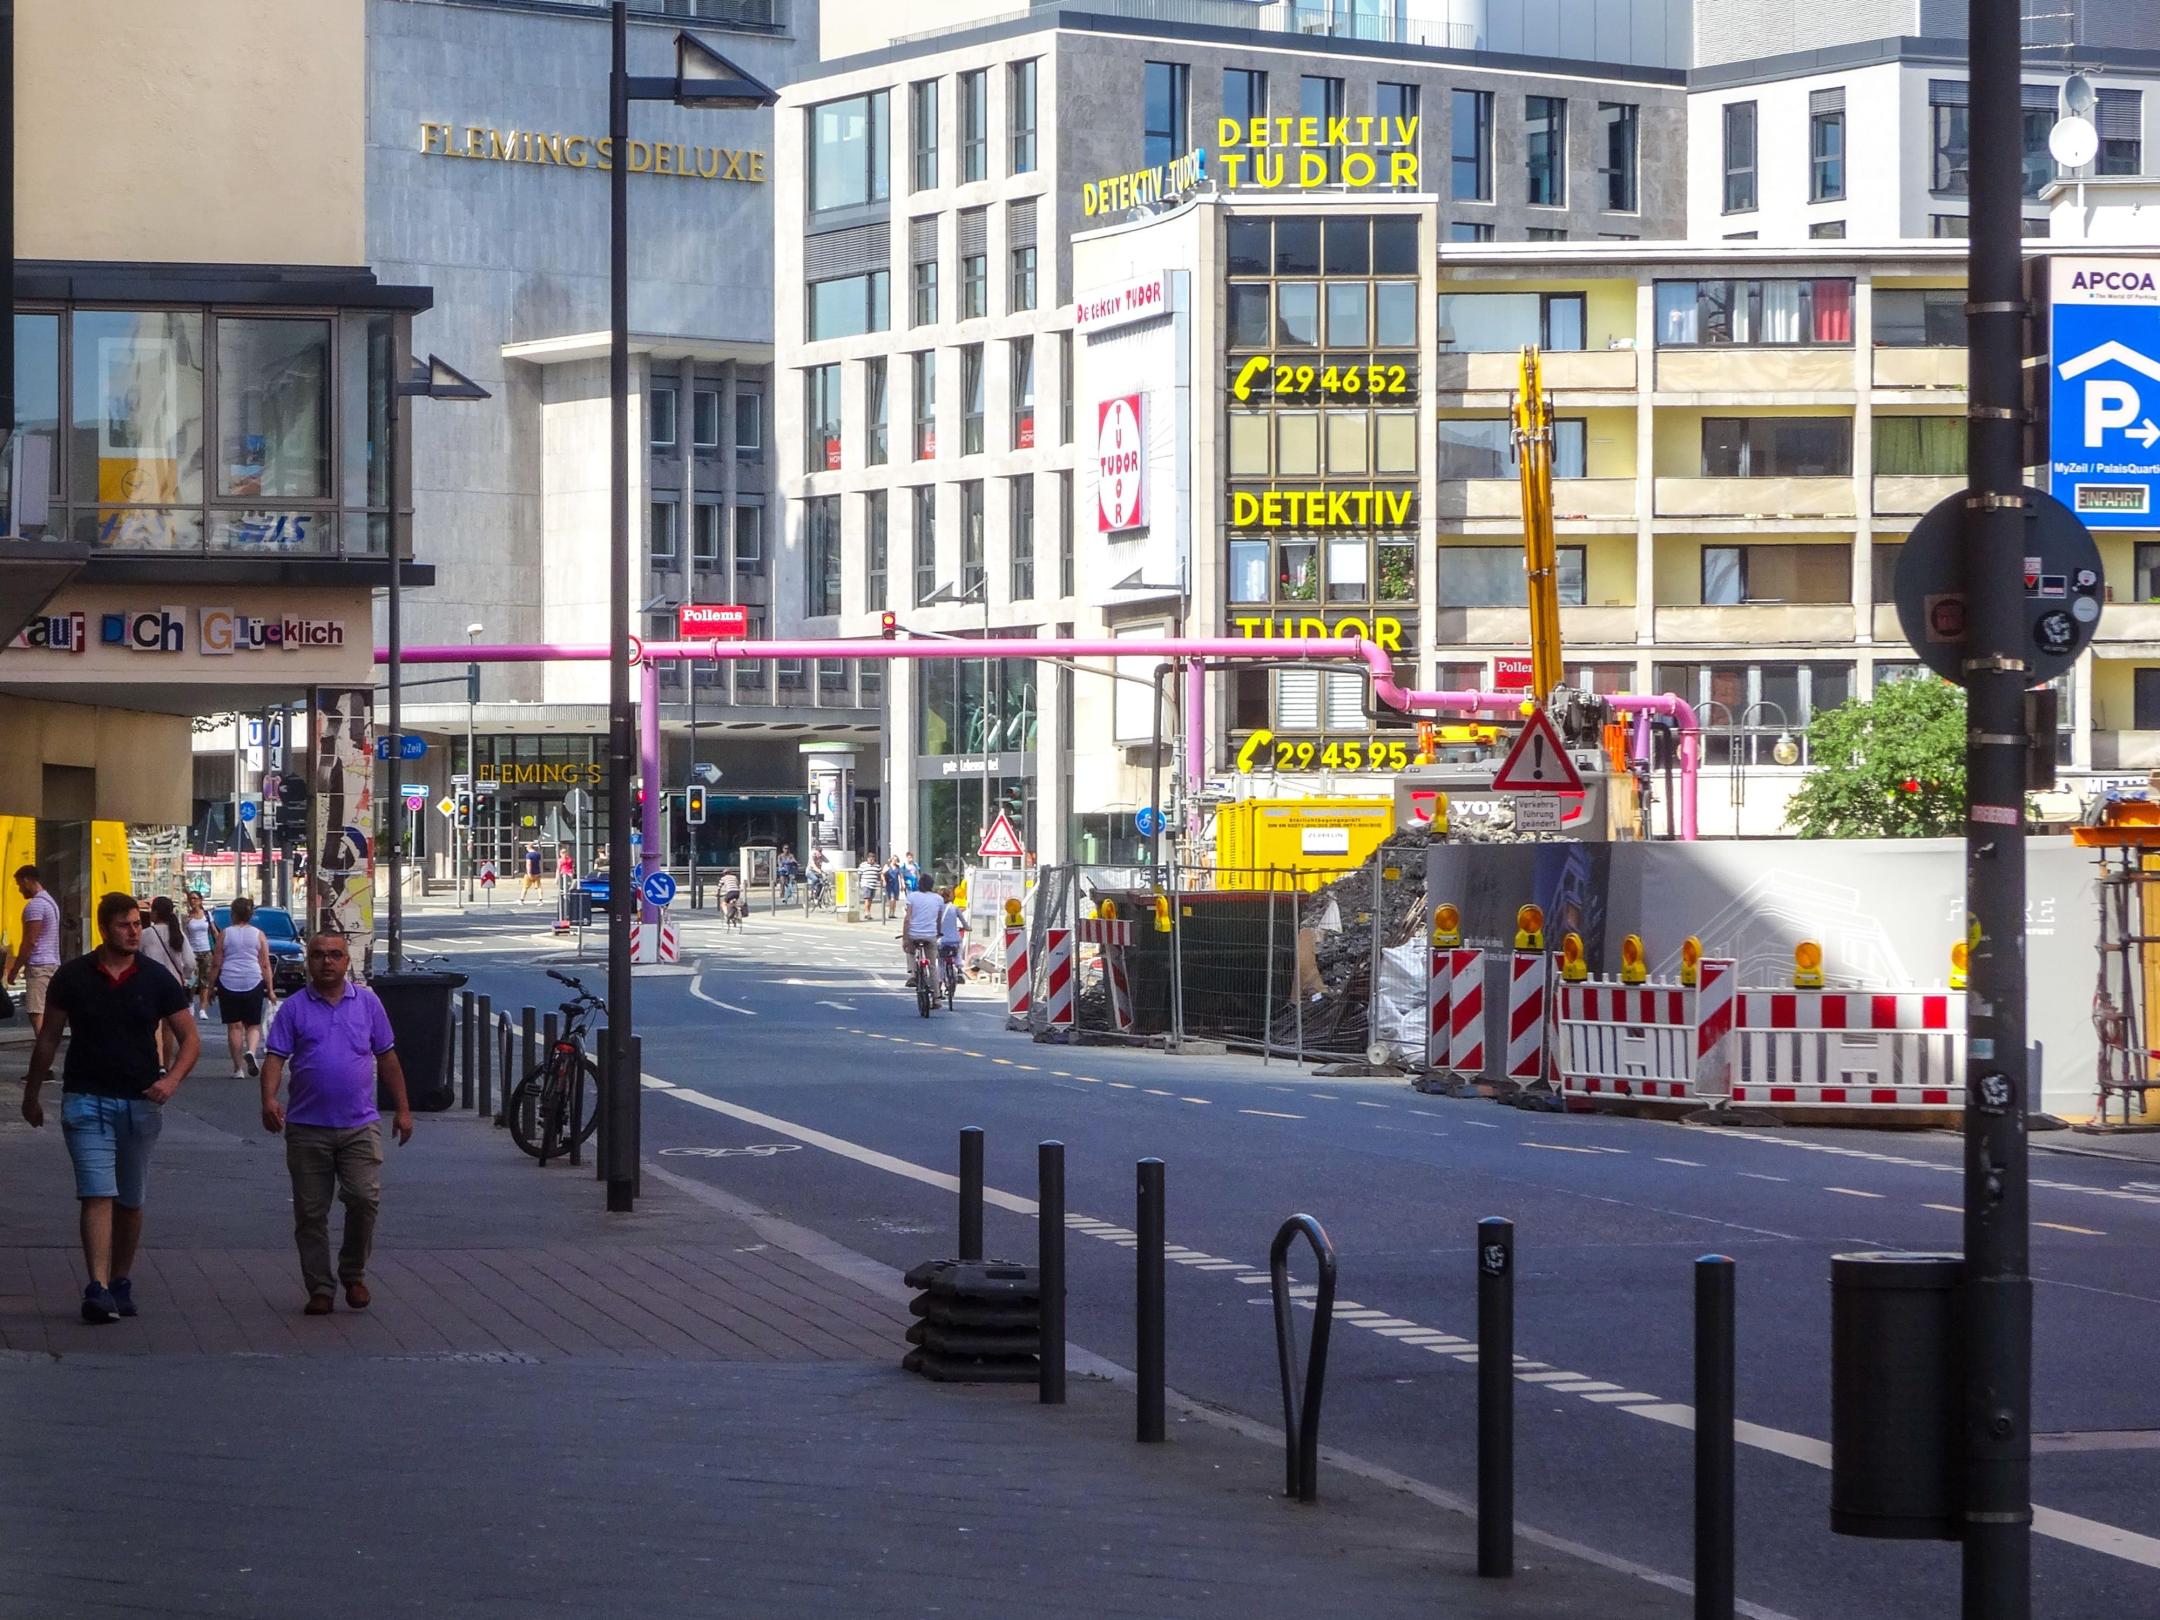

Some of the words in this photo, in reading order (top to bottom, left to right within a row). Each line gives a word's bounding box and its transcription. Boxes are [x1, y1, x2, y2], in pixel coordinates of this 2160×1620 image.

[1218, 116, 1418, 148] DETEKTIV
[420, 122, 612, 169] FLEMING'S
[627, 138, 767, 182] DELUXE
[1084, 166, 1163, 216] DETEKTIV
[1169, 148, 1204, 193] TUDOR
[1220, 152, 1418, 188] TUDOR
[2072, 271, 2156, 291] APCOA
[1125, 281, 1161, 310] TUDOR
[2084, 379, 2141, 447] P
[1100, 450, 1138, 478] TUDOR
[2054, 462, 2088, 475] MyZeil
[2096, 463, 2160, 474] PalaisQuarti
[1234, 490, 1412, 526] DETEKTIV
[2079, 491, 2142, 507] EINFAHRT
[683, 609, 743, 622] Pollems
[20, 615, 84, 652] auF
[402, 742, 422, 756] yZeil
[479, 763, 602, 785] FLEMING'S
[1519, 800, 1558, 809] Verkehrs-
[1523, 810, 1554, 819] führung
[1521, 820, 1557, 829] geändert
